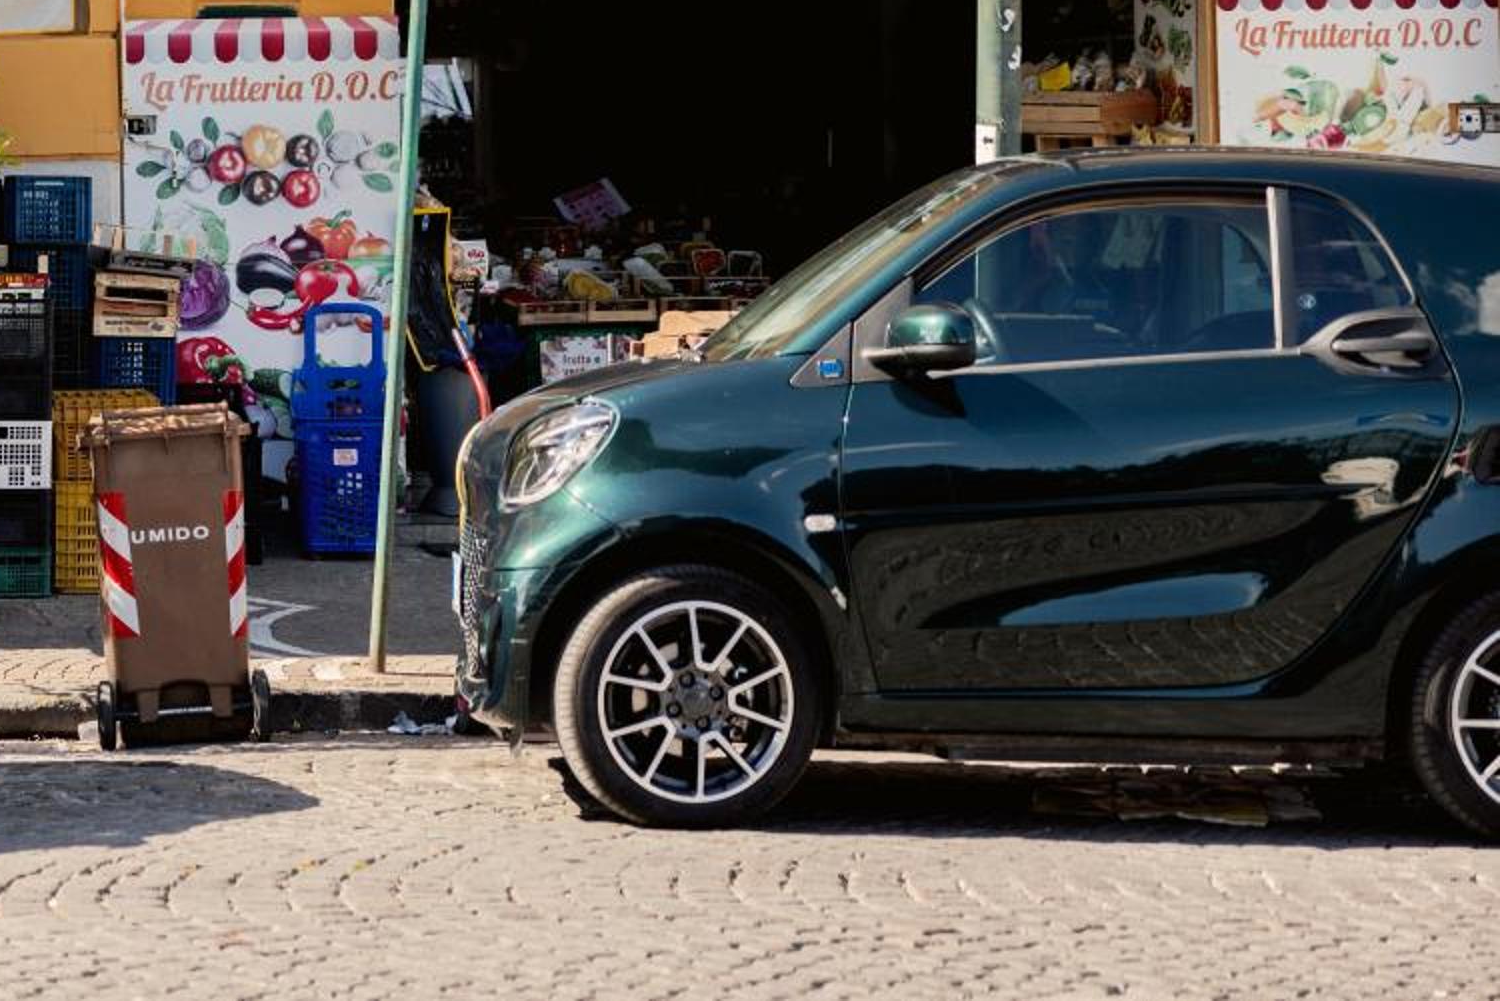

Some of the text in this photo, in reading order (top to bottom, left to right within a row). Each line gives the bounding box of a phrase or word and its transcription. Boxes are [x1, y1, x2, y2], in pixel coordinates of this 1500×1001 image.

[1235, 17, 1482, 56] La Frutteria D.O.C
[140, 71, 175, 111] La
[179, 73, 303, 103] Frutteria
[131, 525, 209, 544] UMIDO
